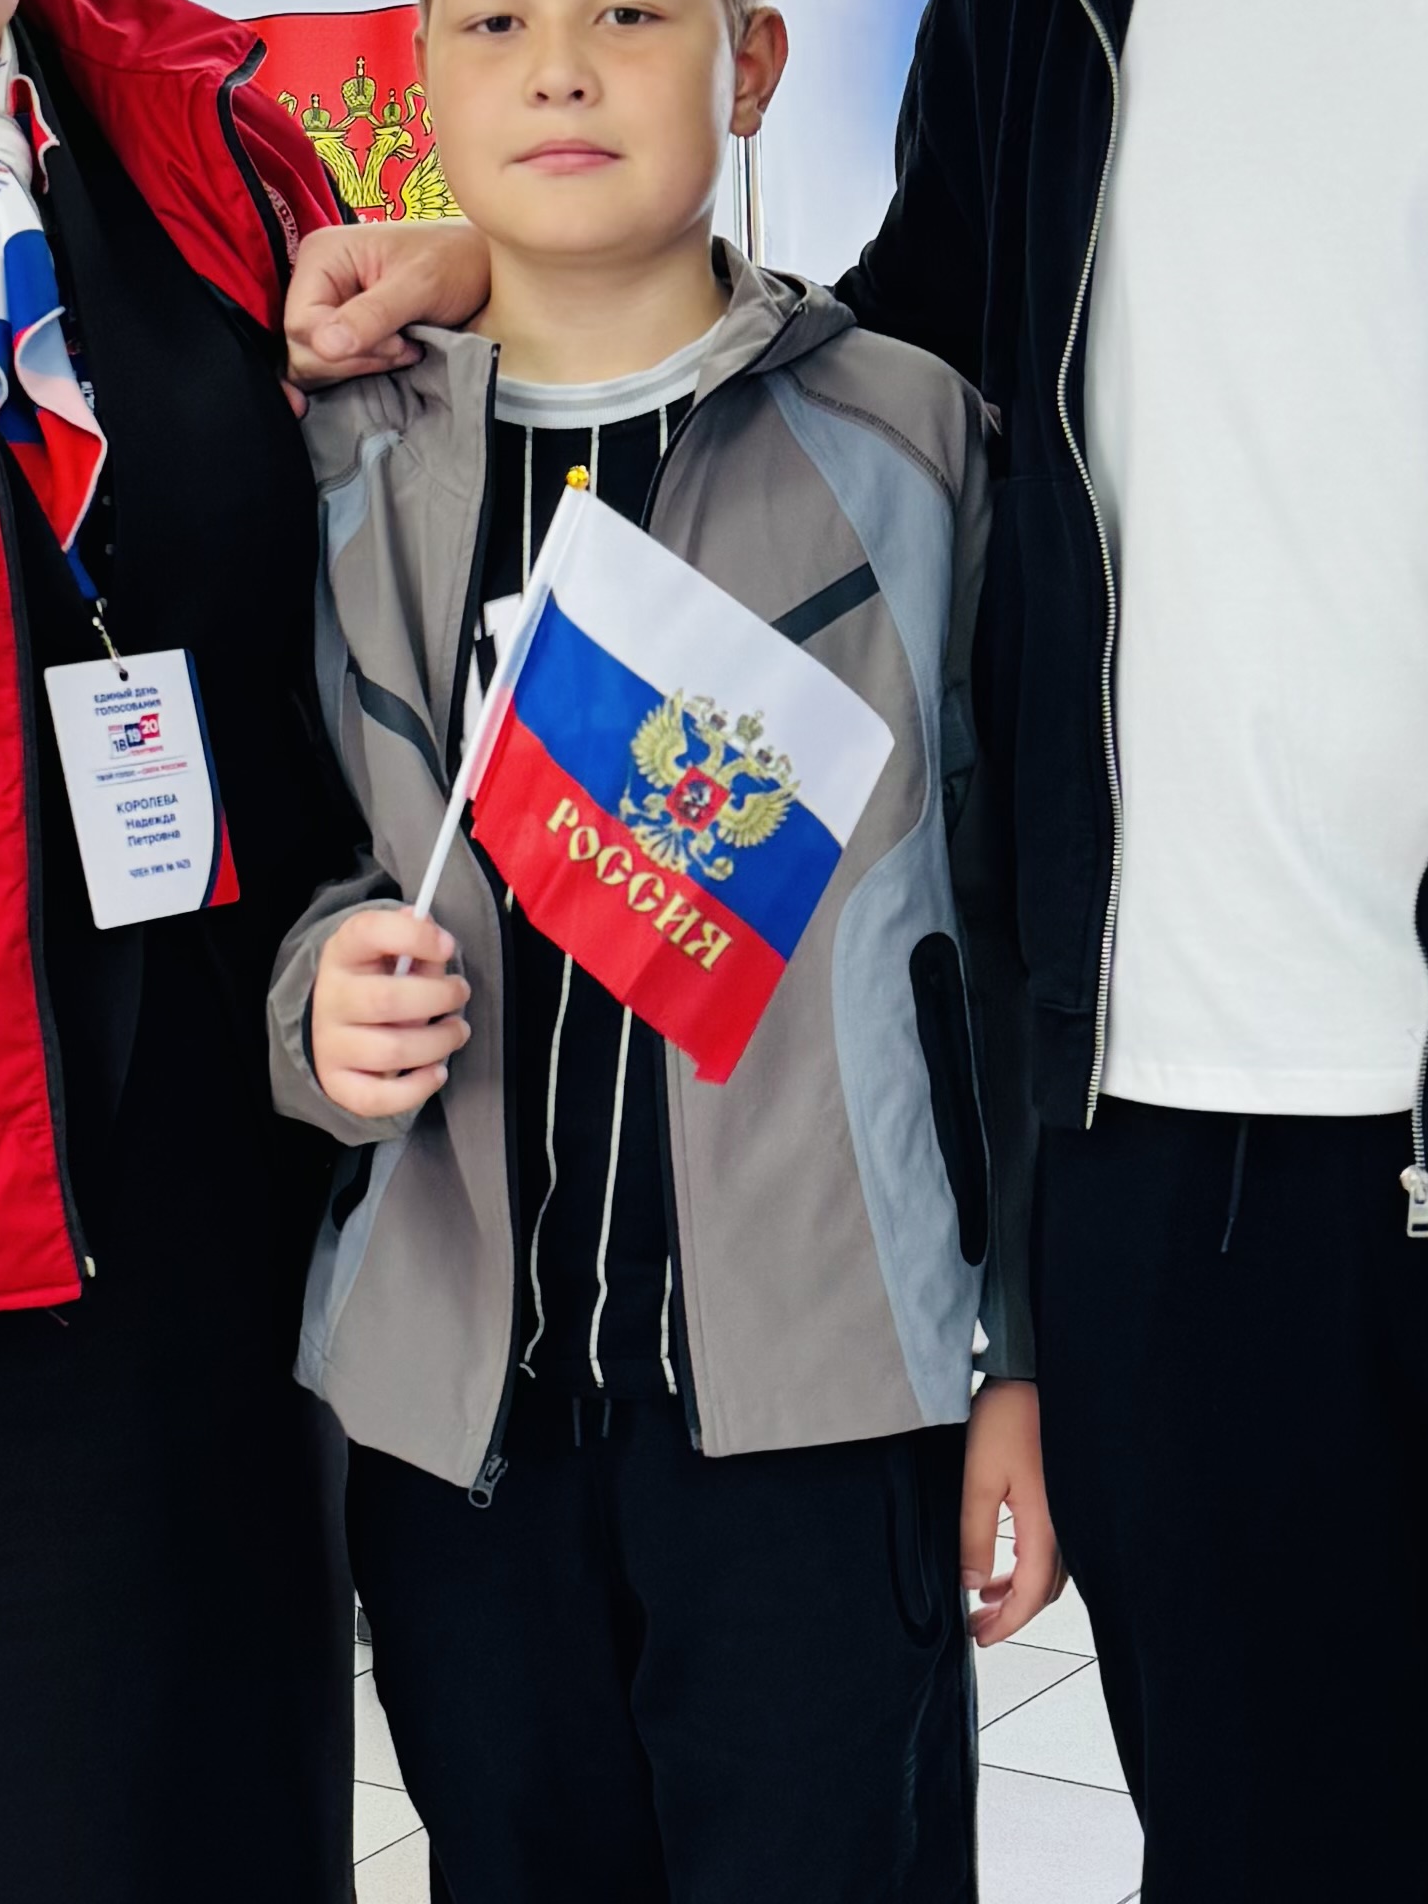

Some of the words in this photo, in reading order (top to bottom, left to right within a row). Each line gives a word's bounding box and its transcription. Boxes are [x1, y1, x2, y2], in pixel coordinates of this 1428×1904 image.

[112, 739, 127, 752] 18
[141, 719, 159, 734] 20
[116, 793, 178, 813] КОРОЛЕВА
[126, 813, 176, 829] Надежда
[128, 829, 181, 847] Петровна
[546, 797, 733, 972] РОССИЯ
